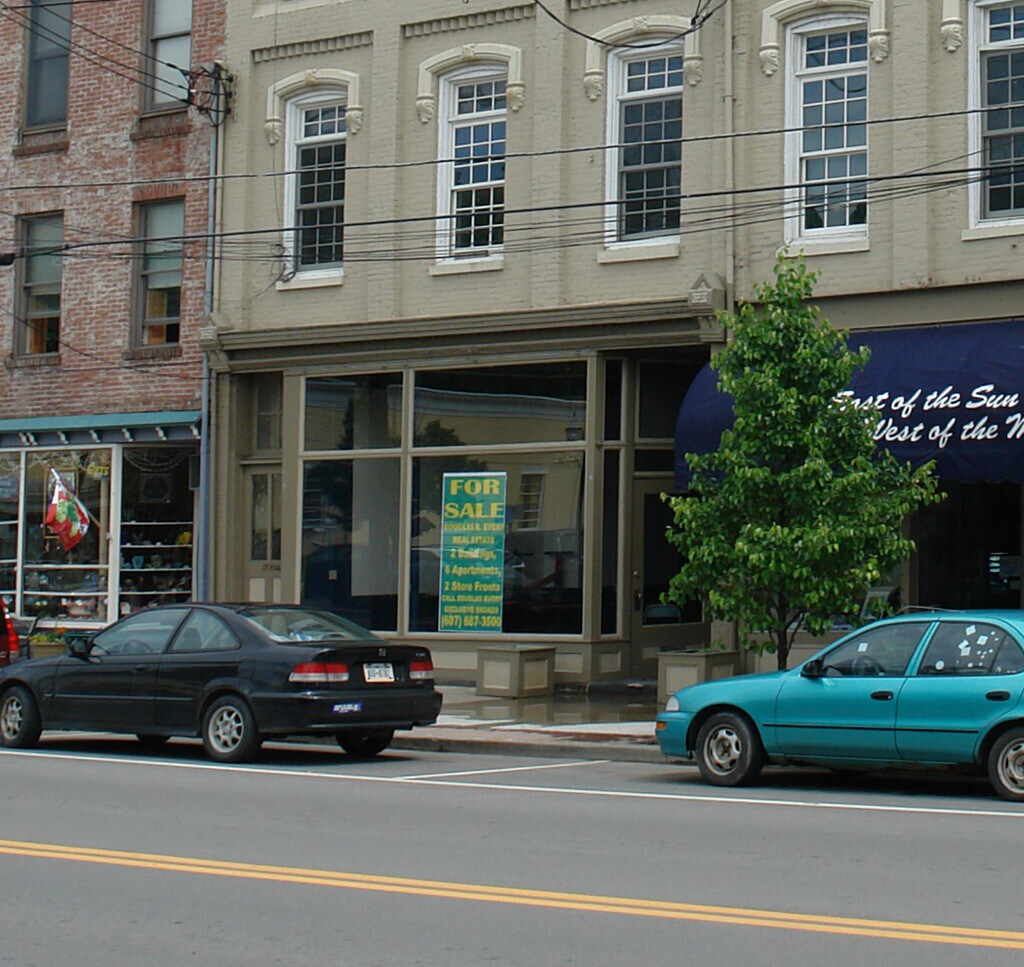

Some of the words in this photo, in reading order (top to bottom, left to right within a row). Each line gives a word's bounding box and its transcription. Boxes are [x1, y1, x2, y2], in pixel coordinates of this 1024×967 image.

[891, 389, 921, 418] of
[923, 385, 961, 411] the
[965, 384, 1020, 409] Sun
[928, 418, 956, 448] of
[960, 416, 998, 440] the
[450, 479, 500, 495] FOR
[444, 502, 505, 518] SALE
[444, 581, 450, 591] 2
[451, 581, 473, 591] Store
[474, 581, 501, 591] Fronts
[441, 615, 462, 629] (607)
